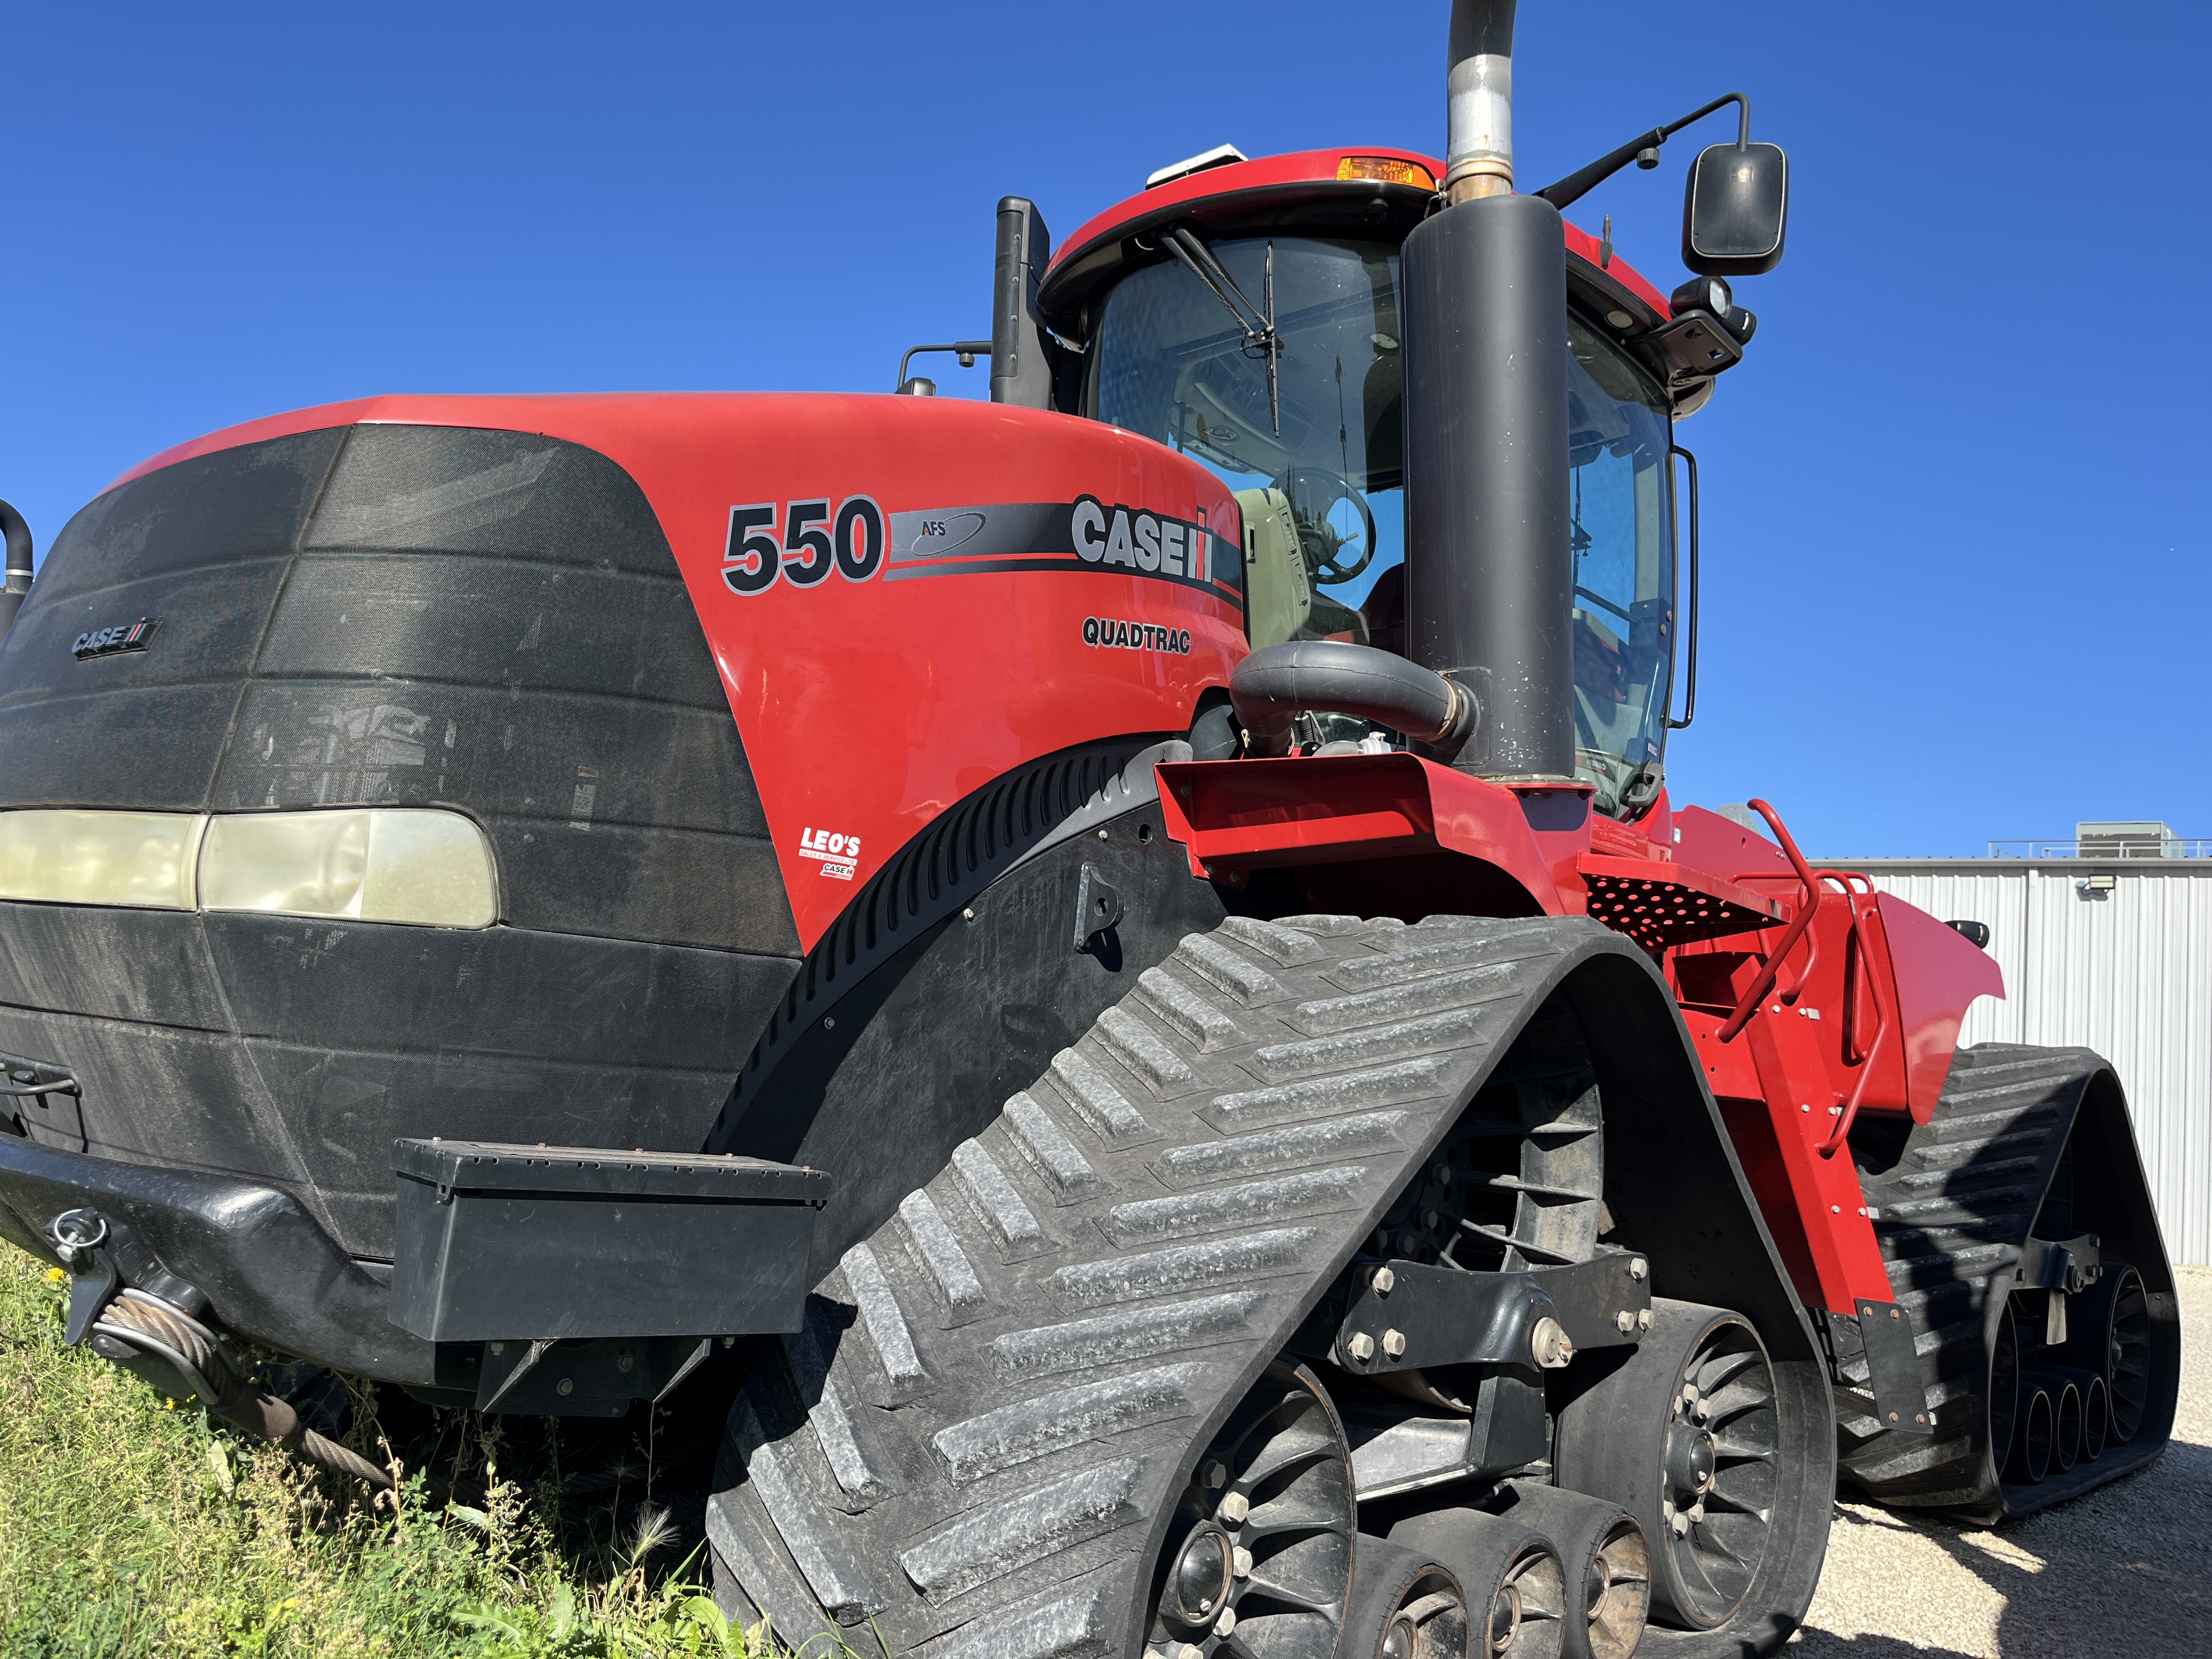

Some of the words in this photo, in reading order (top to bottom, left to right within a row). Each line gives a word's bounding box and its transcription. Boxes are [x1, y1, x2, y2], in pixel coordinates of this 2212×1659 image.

[922, 520, 946, 536] AFS
[720, 494, 885, 596] 550
[1082, 616, 1191, 656] QUADTRAC
[800, 827, 861, 857] LEO'S
[823, 854, 844, 863] SERVICE
[824, 864, 846, 873] CASE
